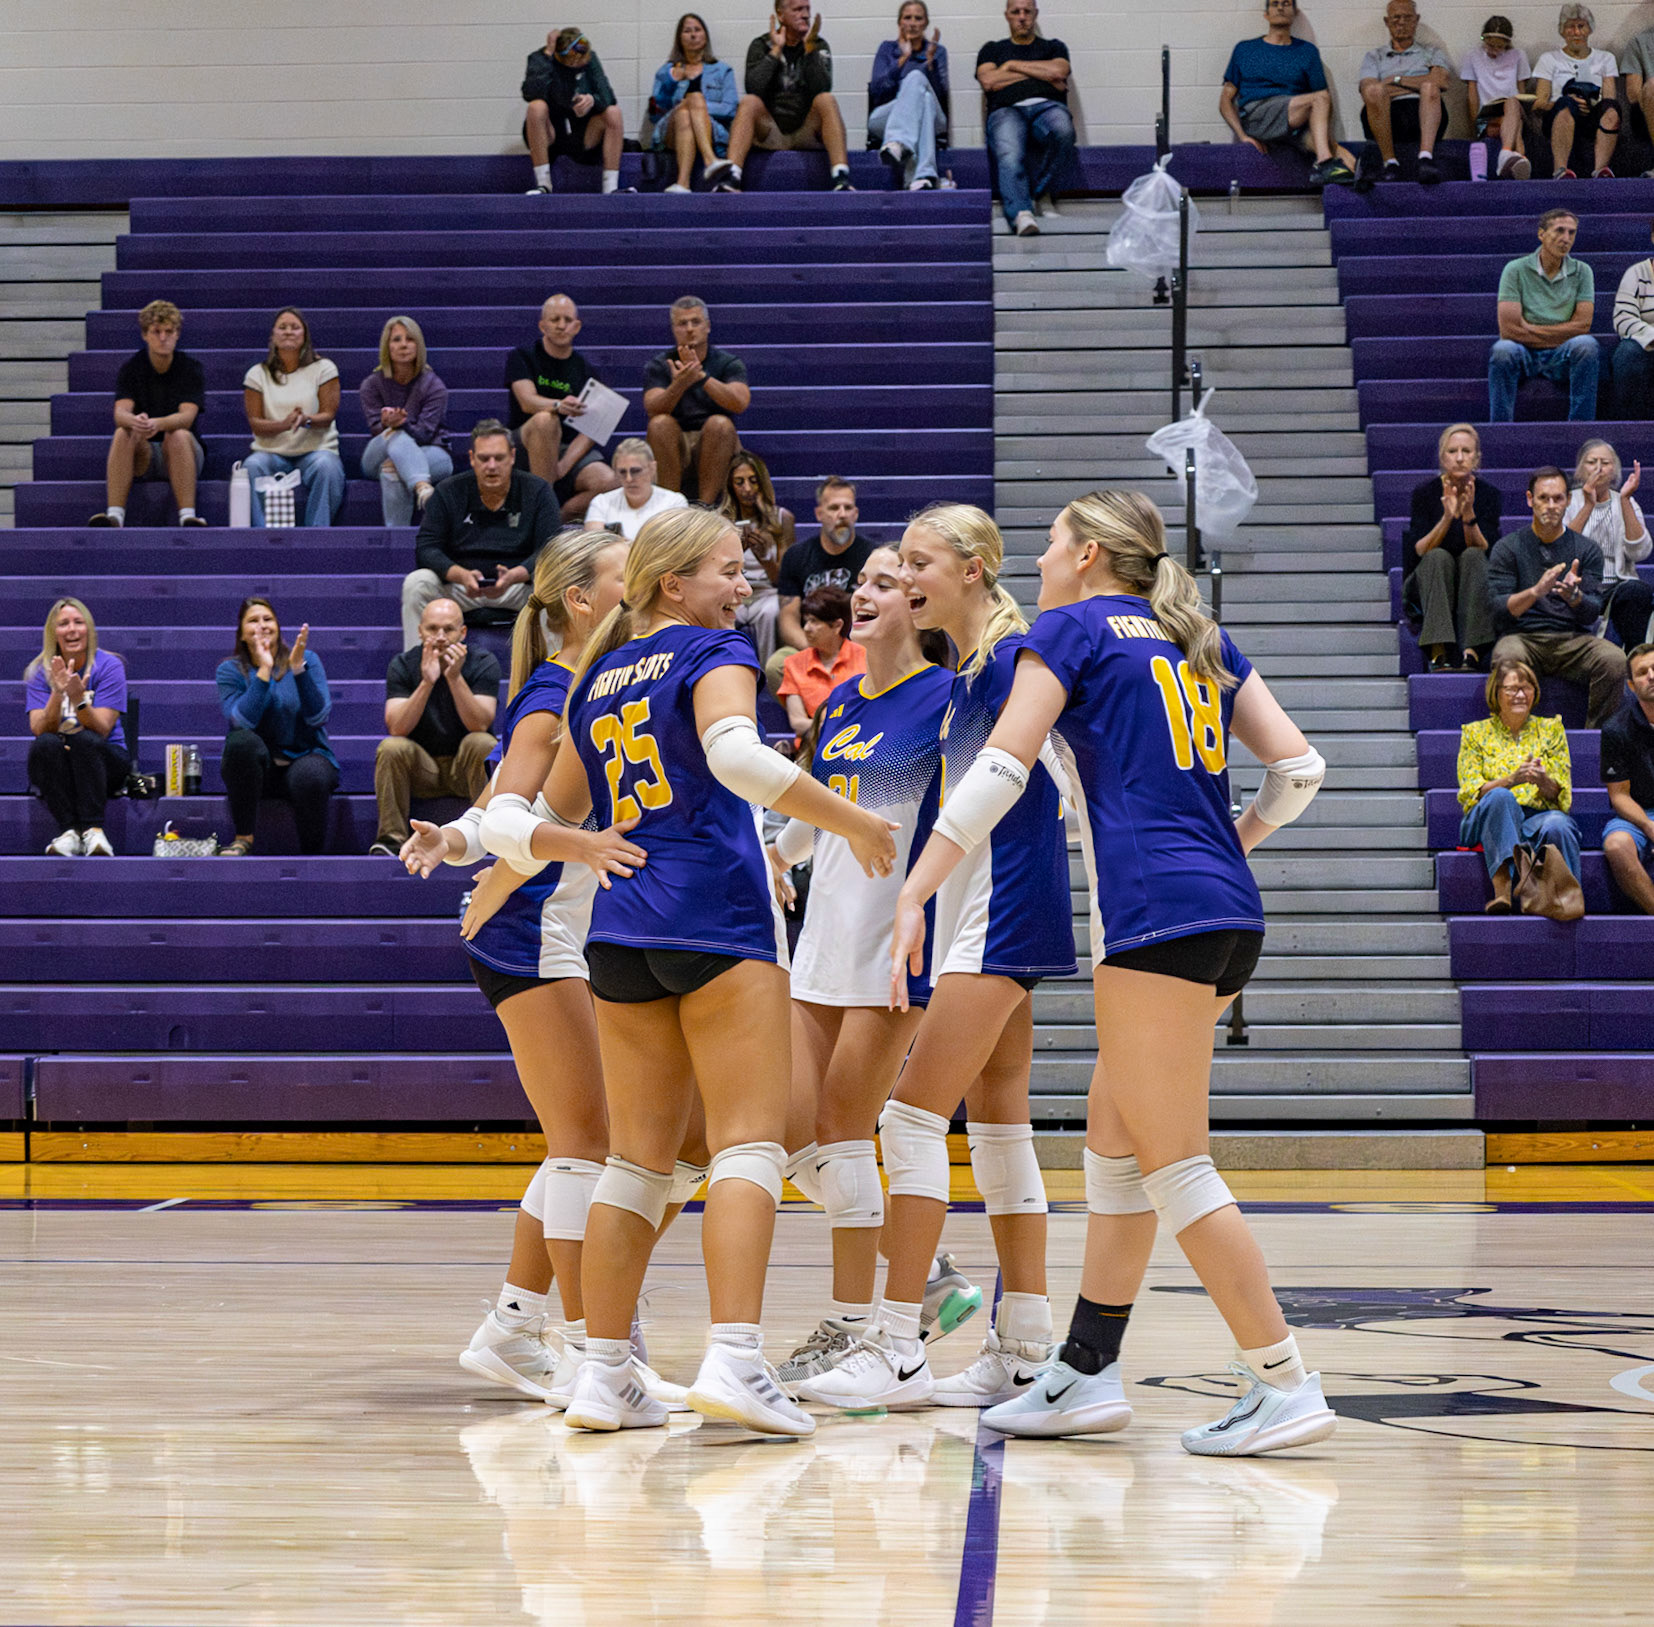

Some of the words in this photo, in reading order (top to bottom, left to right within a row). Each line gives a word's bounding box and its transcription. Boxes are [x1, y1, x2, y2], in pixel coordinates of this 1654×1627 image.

[590, 697, 673, 825] 25
[822, 723, 884, 761] Cal
[1150, 655, 1227, 775] 18
